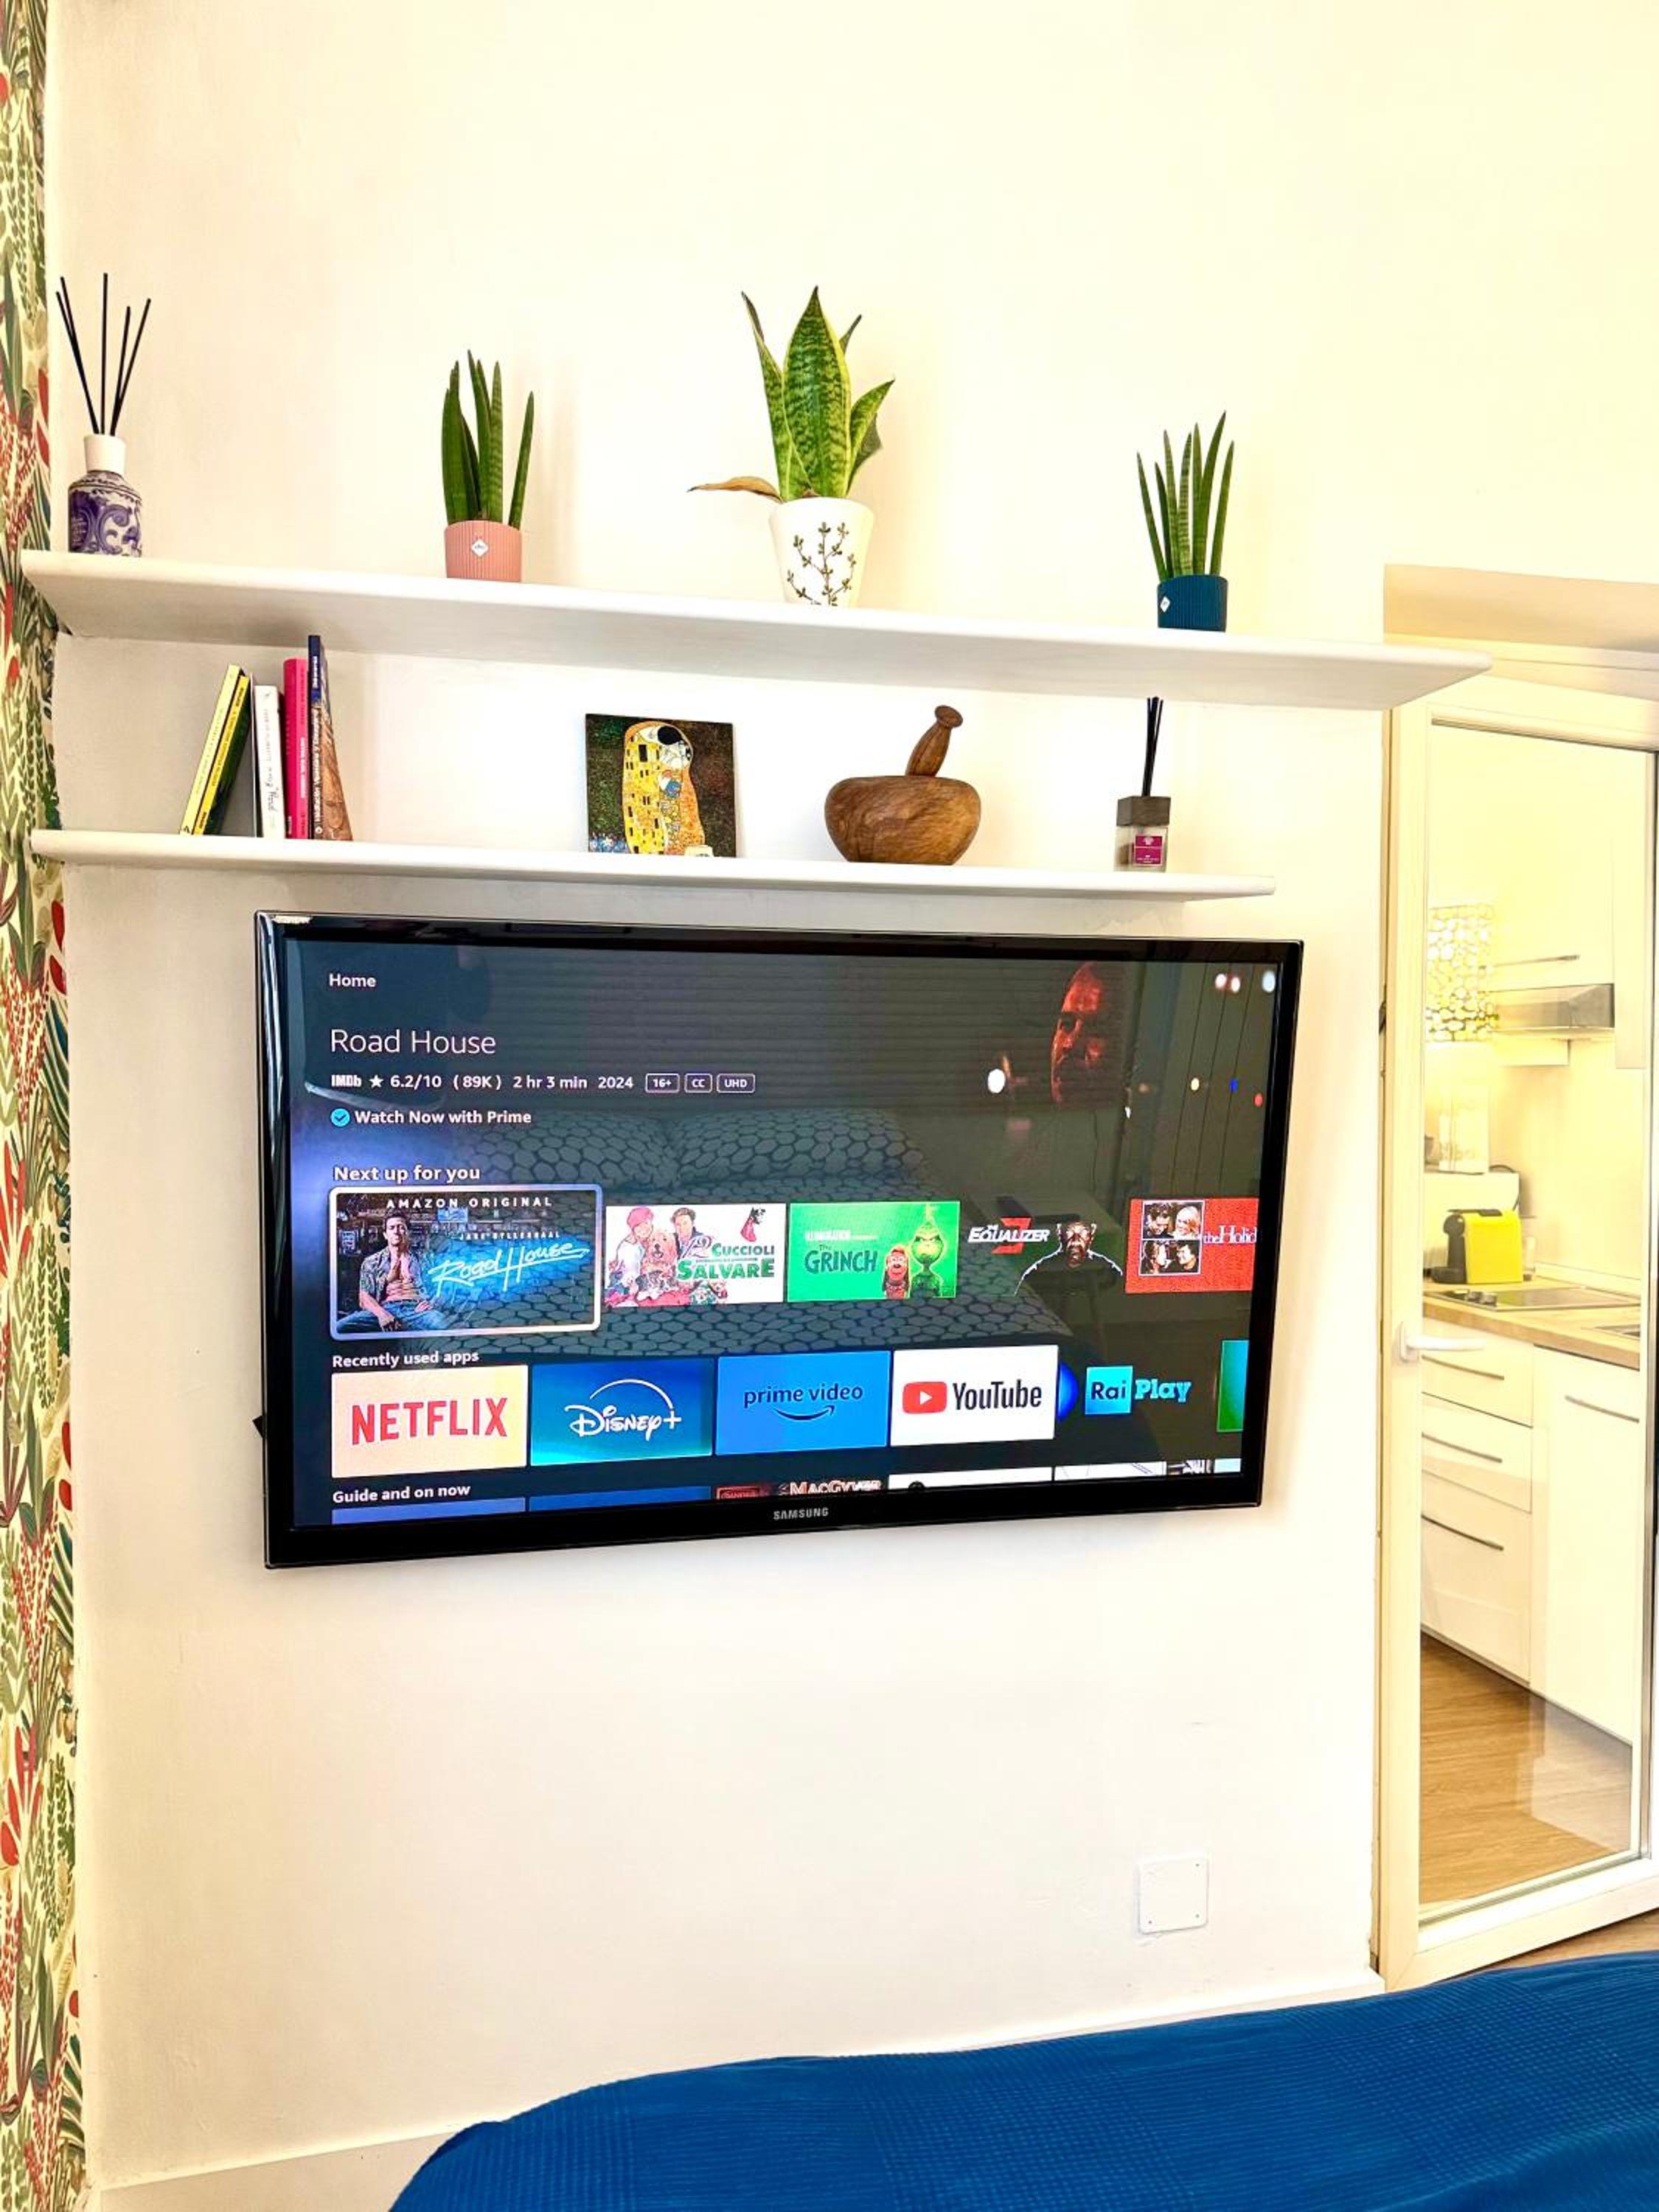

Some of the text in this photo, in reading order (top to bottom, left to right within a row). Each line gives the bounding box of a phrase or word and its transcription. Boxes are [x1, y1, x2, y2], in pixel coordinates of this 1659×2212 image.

[329, 973, 377, 988] Home
[330, 1029, 496, 1054] Road House
[331, 1074, 362, 1088] IMDb
[390, 1074, 442, 1090] 6.2/10
[512, 1077, 523, 1089] 2
[526, 1076, 543, 1089] hr
[546, 1077, 555, 1089] 3
[560, 1077, 588, 1089] min
[598, 1077, 634, 1089] 2024
[653, 1078, 672, 1089] 16+
[691, 1078, 706, 1089] CC
[724, 1078, 748, 1089] UHD
[355, 1110, 532, 1124] Watch Now with Prime
[334, 1165, 480, 1185] Next up for you
[386, 1197, 553, 1209] AMAZON ORIGINAL
[428, 1242, 590, 1298] Road House
[677, 1258, 775, 1280] SALVARE
[804, 1250, 878, 1274] GRINCH
[332, 1352, 479, 1370] Recently used apps
[743, 1383, 863, 1408] prime video
[953, 1380, 1043, 1411] YouTube
[351, 1397, 508, 1445] NETFLIX
[332, 1486, 471, 1503] Guide and on now
[773, 1507, 830, 1520] SAMSUNG
